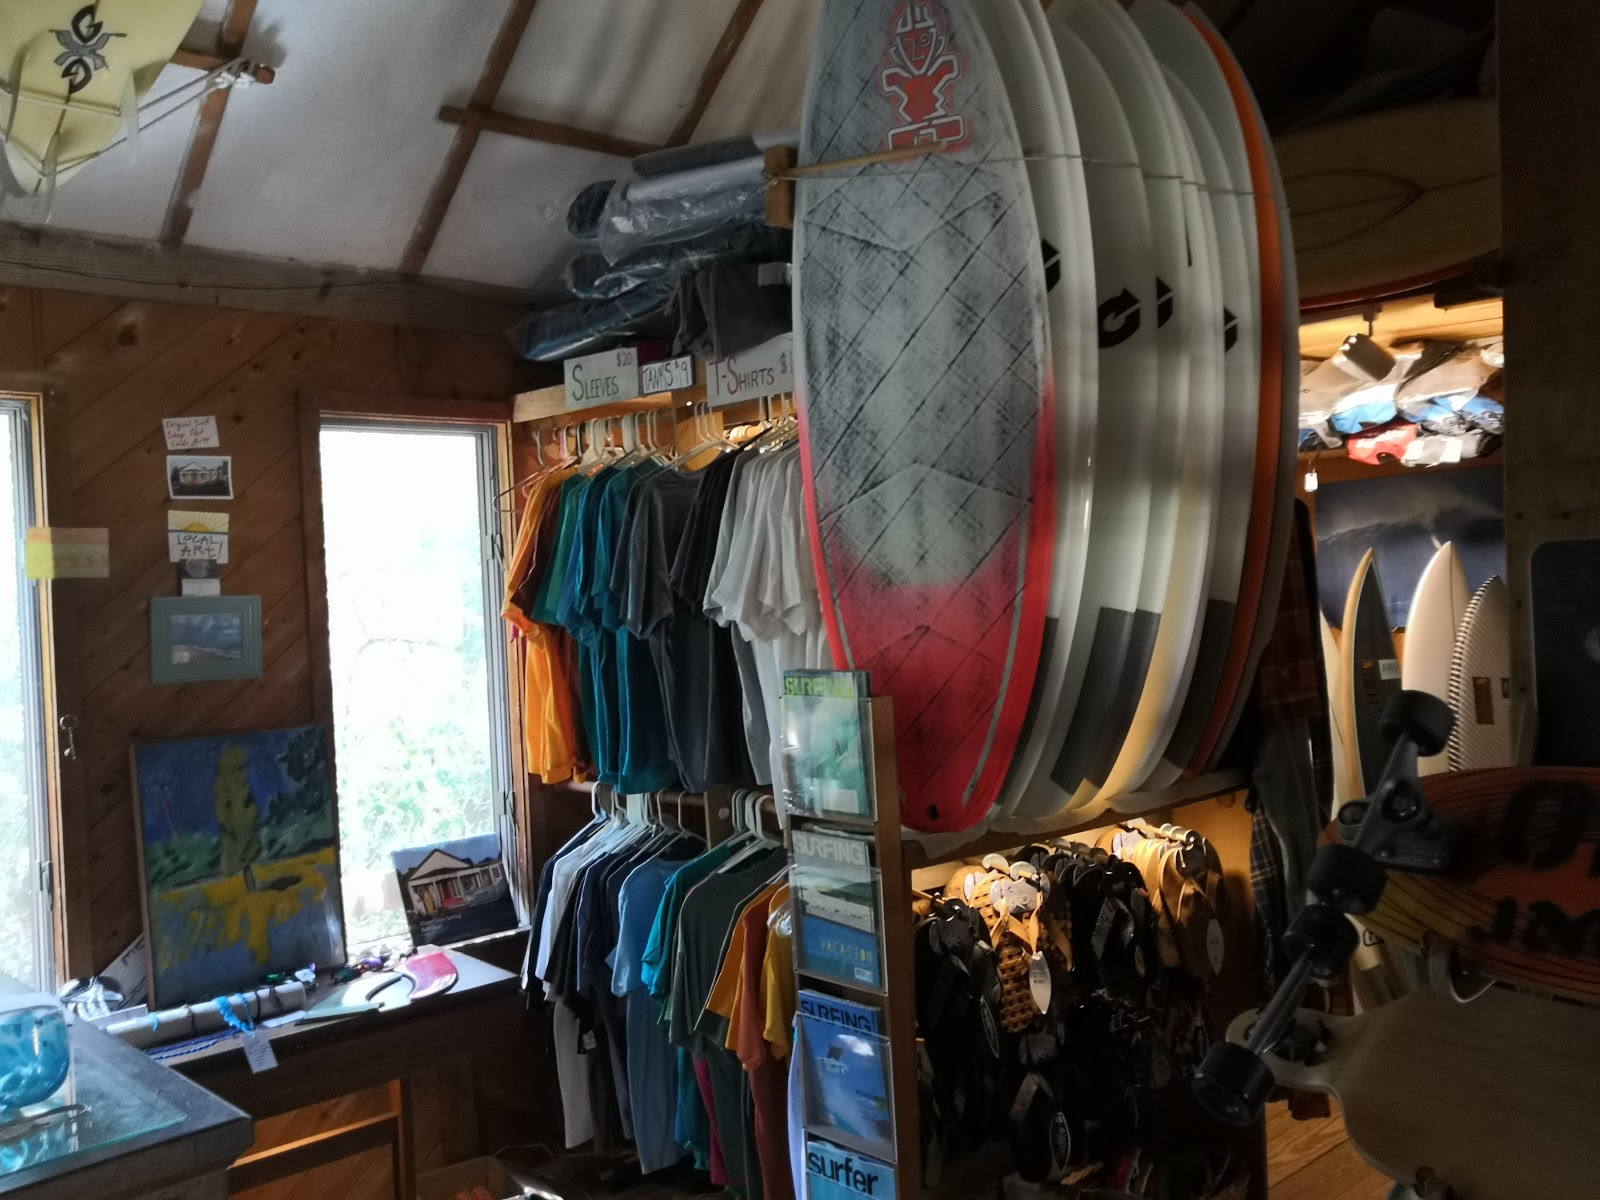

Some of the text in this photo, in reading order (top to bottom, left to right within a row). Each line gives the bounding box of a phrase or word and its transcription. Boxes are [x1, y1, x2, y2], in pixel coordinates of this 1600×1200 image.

[616, 352, 634, 368] $20
[642, 361, 674, 391] TANKS
[708, 349, 794, 396] T-SHIRTS $1
[571, 363, 620, 402] SLEEVES
[176, 534, 220, 546] LOCAL
[793, 832, 867, 867] SURFING
[800, 1000, 873, 1037] SURFING
[807, 1151, 879, 1197] surfer
